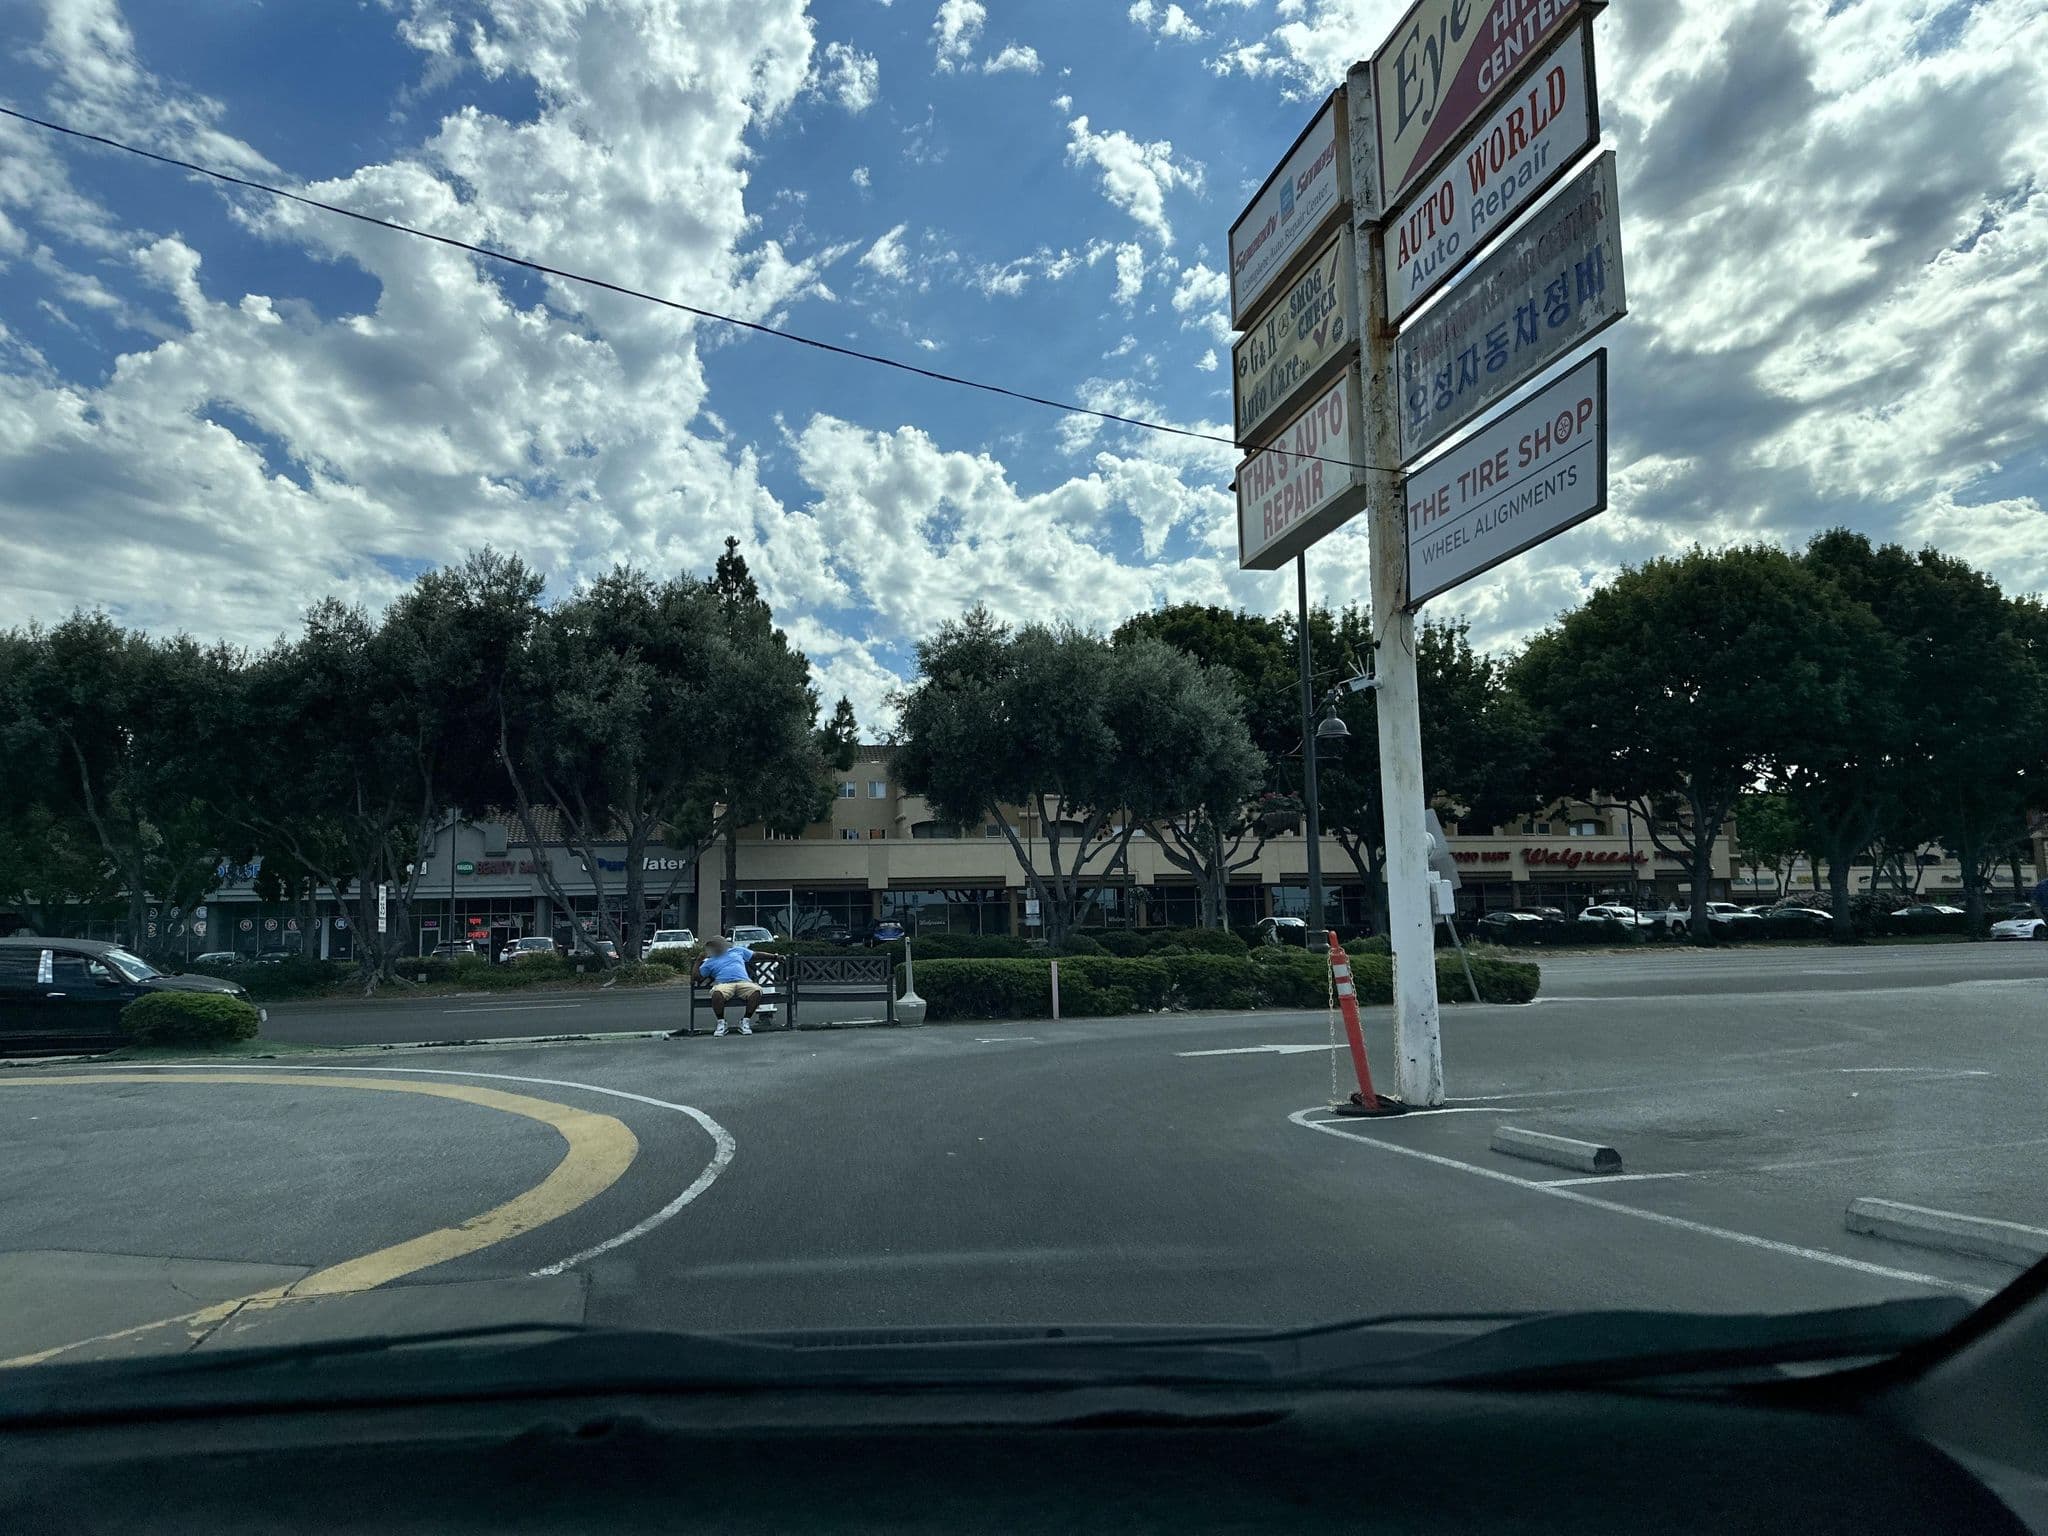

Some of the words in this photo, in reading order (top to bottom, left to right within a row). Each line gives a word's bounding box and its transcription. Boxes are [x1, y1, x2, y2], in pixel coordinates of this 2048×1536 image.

[1397, 180, 1455, 270] AUTO
[1466, 65, 1566, 196] WORLD
[1411, 230, 1460, 291] Auto
[1471, 140, 1551, 233] Repair
[1290, 268, 1321, 319] SMOG
[1298, 283, 1336, 340] CHECK
[1240, 385, 1266, 432] Auto
[1270, 354, 1299, 400] Care
[1295, 390, 1343, 466] AUTO
[1263, 460, 1325, 540] REPAIR
[1410, 484, 1450, 532] THE
[1457, 448, 1509, 502] TIRE
[1518, 397, 1593, 468] SHOP
[1422, 530, 1470, 565] WHEEL
[1474, 465, 1577, 539] ALIGNMENTS
[643, 857, 686, 870] ater
[1519, 848, 1649, 869] Walgreens
